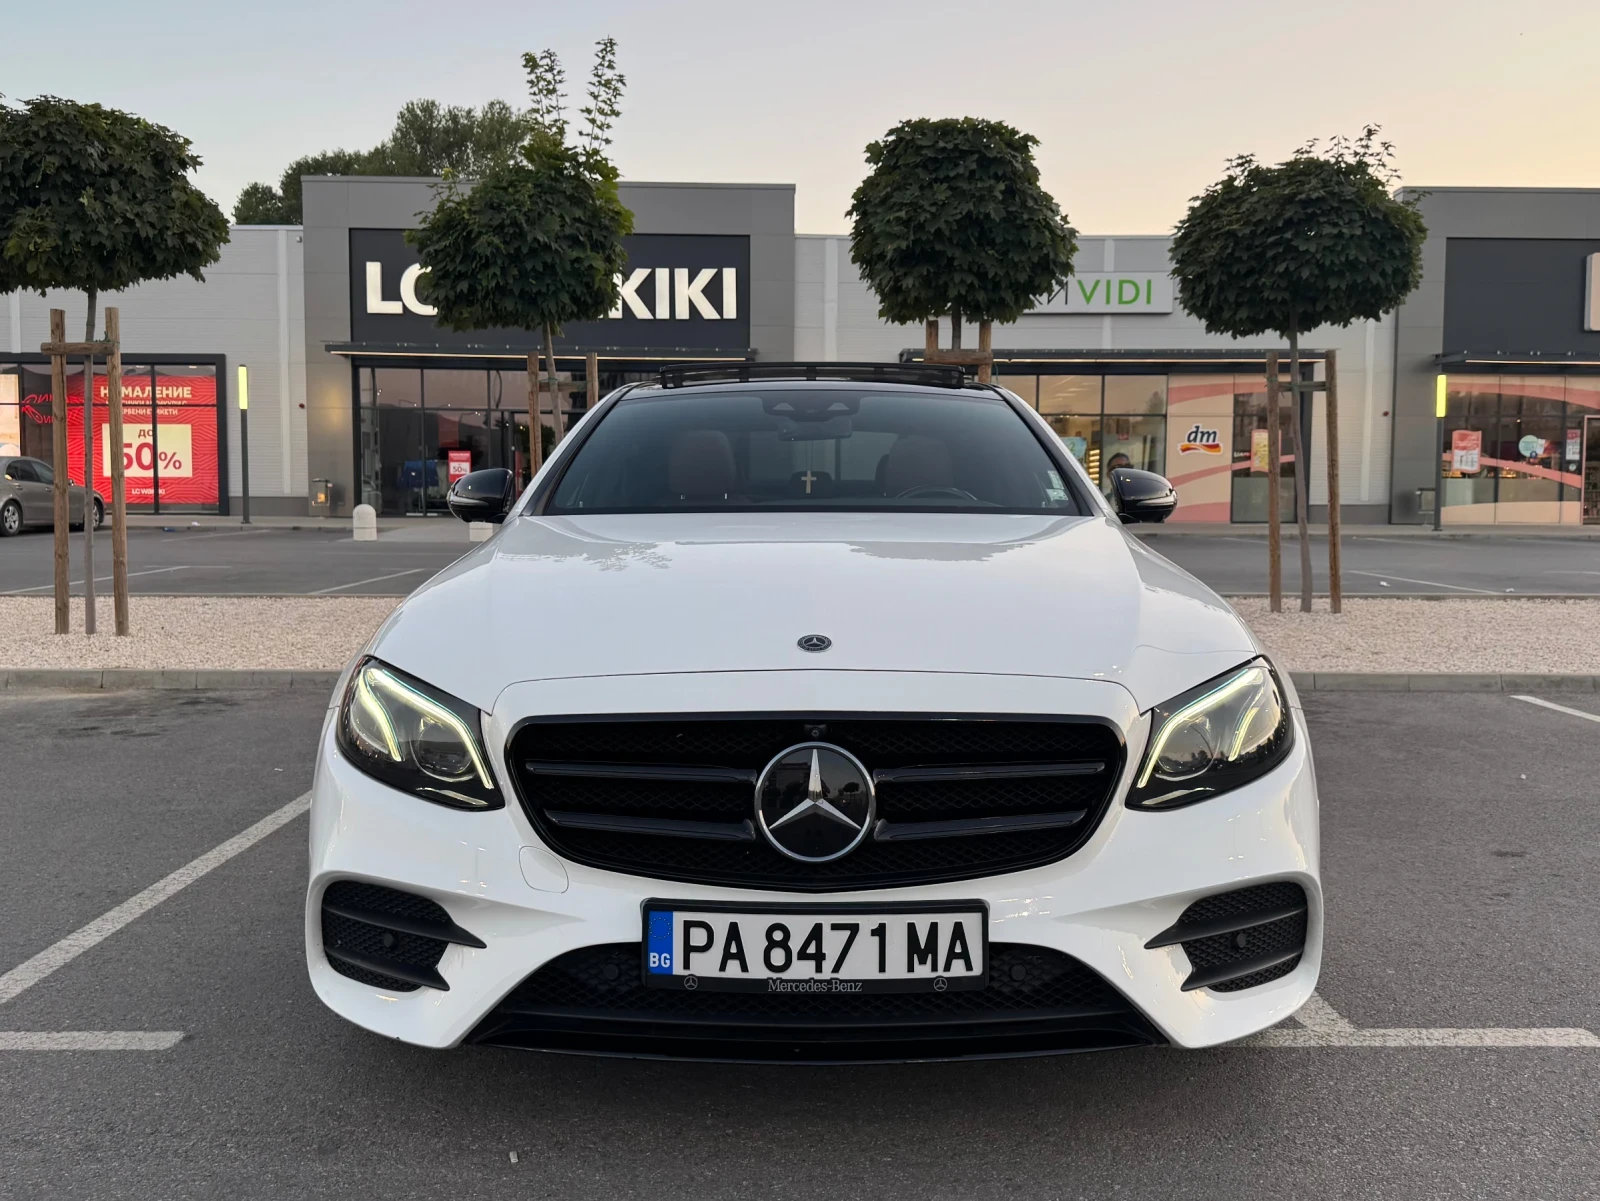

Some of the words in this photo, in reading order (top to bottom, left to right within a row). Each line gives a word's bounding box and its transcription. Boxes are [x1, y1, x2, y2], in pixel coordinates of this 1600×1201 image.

[366, 261, 438, 316] LC
[598, 267, 737, 320] KIKI
[1077, 279, 1152, 305] VIDI
[100, 386, 192, 398] НМАЛЕНИЕ
[1187, 425, 1217, 443] dm
[122, 442, 183, 471] 50%
[682, 919, 750, 973] PA
[763, 922, 887, 974] 8471
[906, 920, 974, 973] MA
[649, 952, 671, 968] BG
[767, 979, 863, 992] Mercedes-Benz
